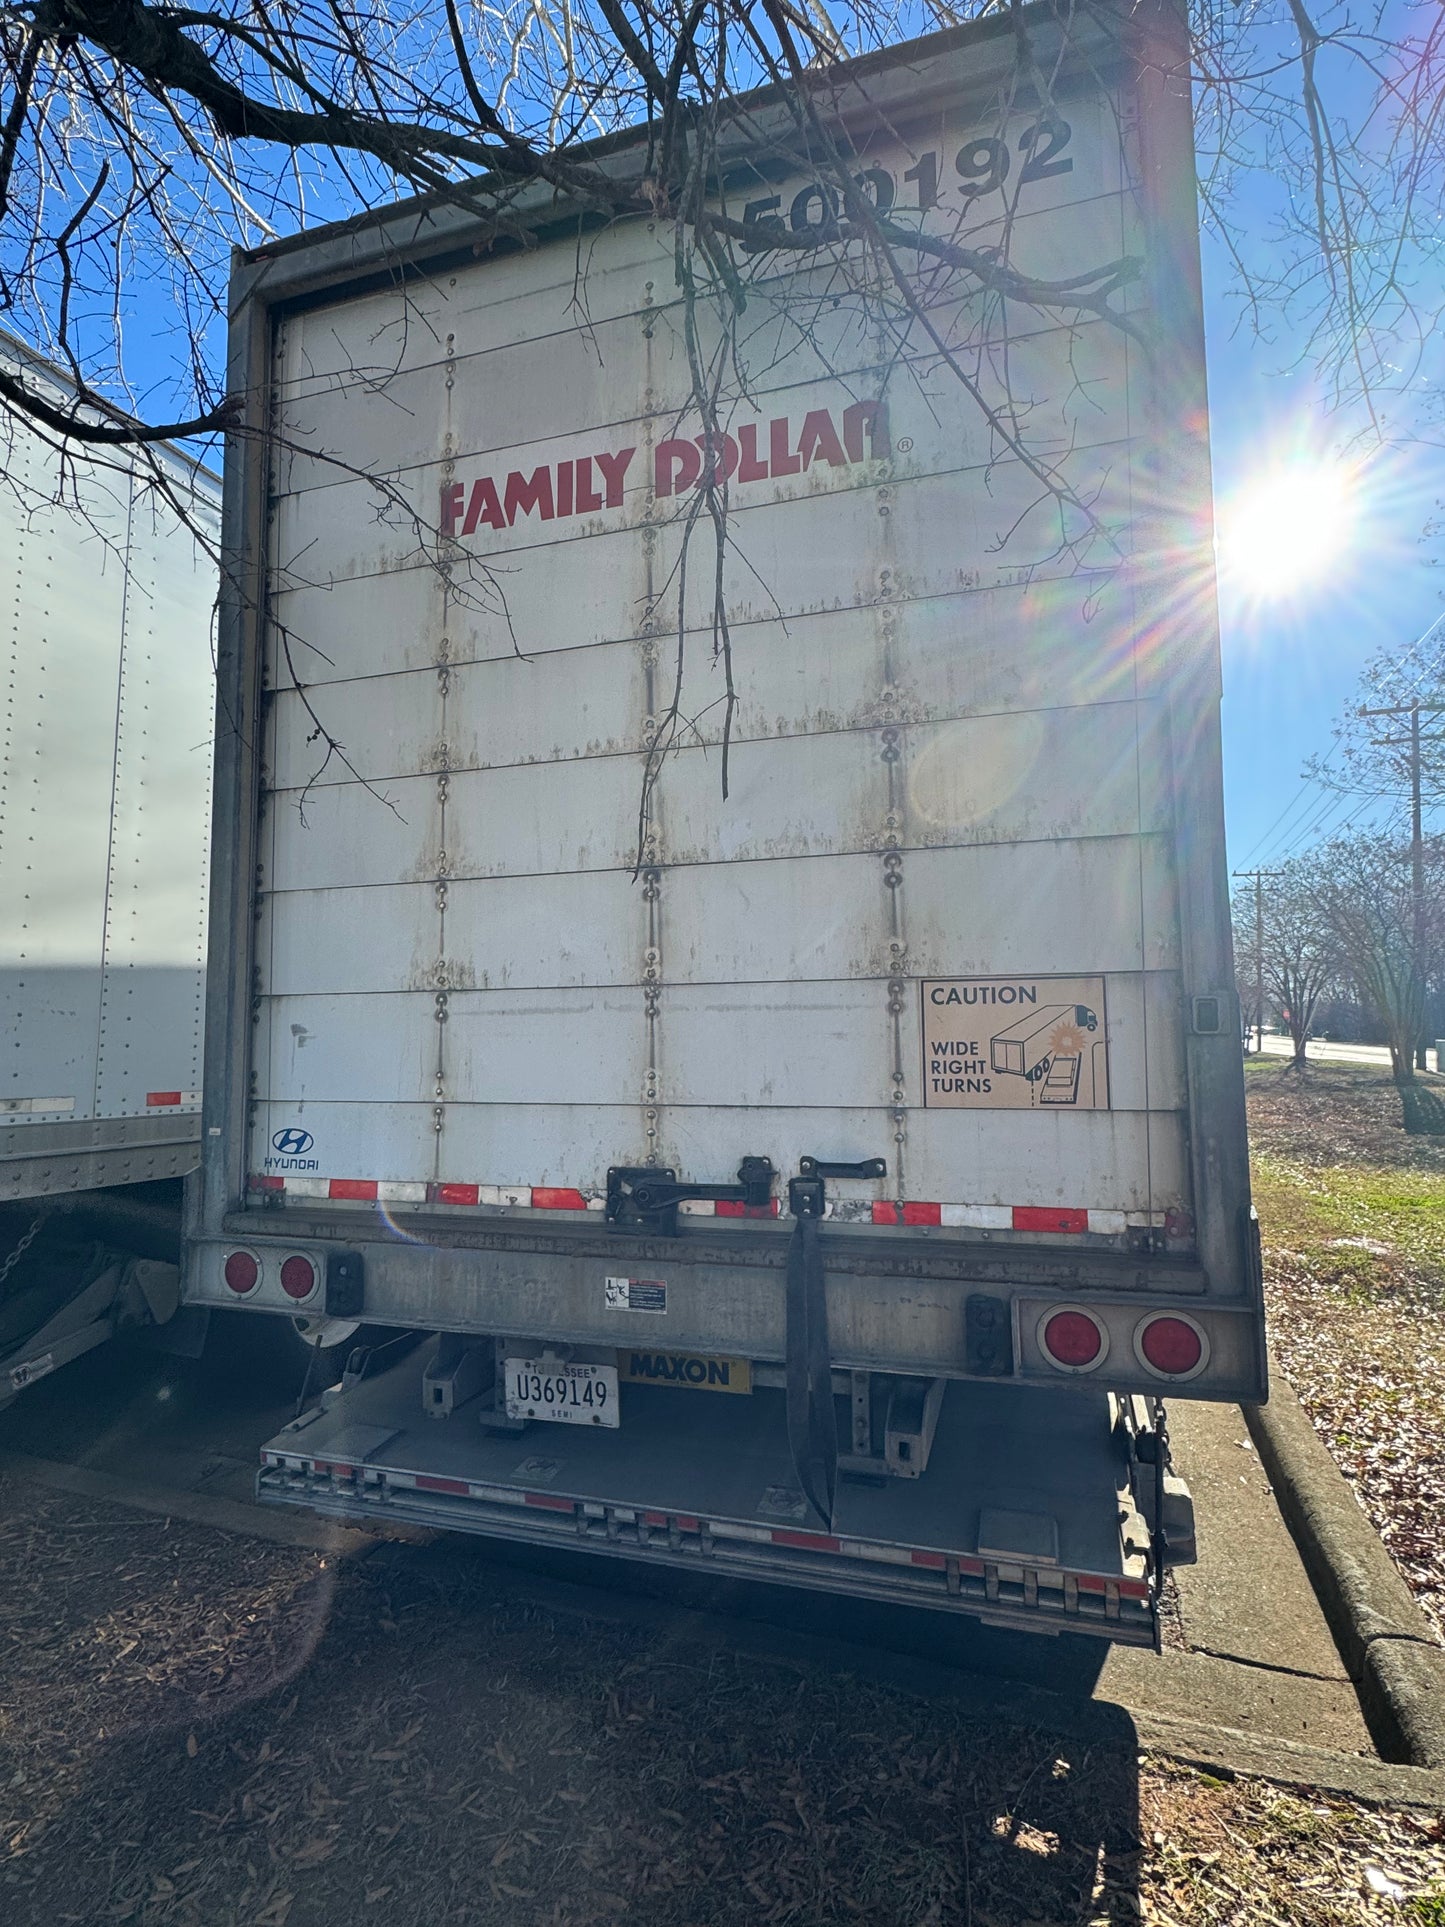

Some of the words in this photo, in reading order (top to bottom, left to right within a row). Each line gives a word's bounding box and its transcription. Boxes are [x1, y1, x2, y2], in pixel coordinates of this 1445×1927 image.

[739, 120, 1073, 254] 500192
[440, 447, 636, 537] FAMILY
[654, 400, 892, 499] DOLLAR
[930, 985, 1037, 1005] CAUTION
[931, 1041, 979, 1056] WIDE
[931, 1060, 987, 1075] RIGHT
[931, 1078, 992, 1093] TURNS
[264, 1157, 319, 1171] HYUNDAI
[532, 1364, 590, 1378] TSSEE
[629, 1353, 730, 1386] MAXON
[517, 1374, 607, 1407] U369149
[551, 1409, 573, 1419] SEMI
